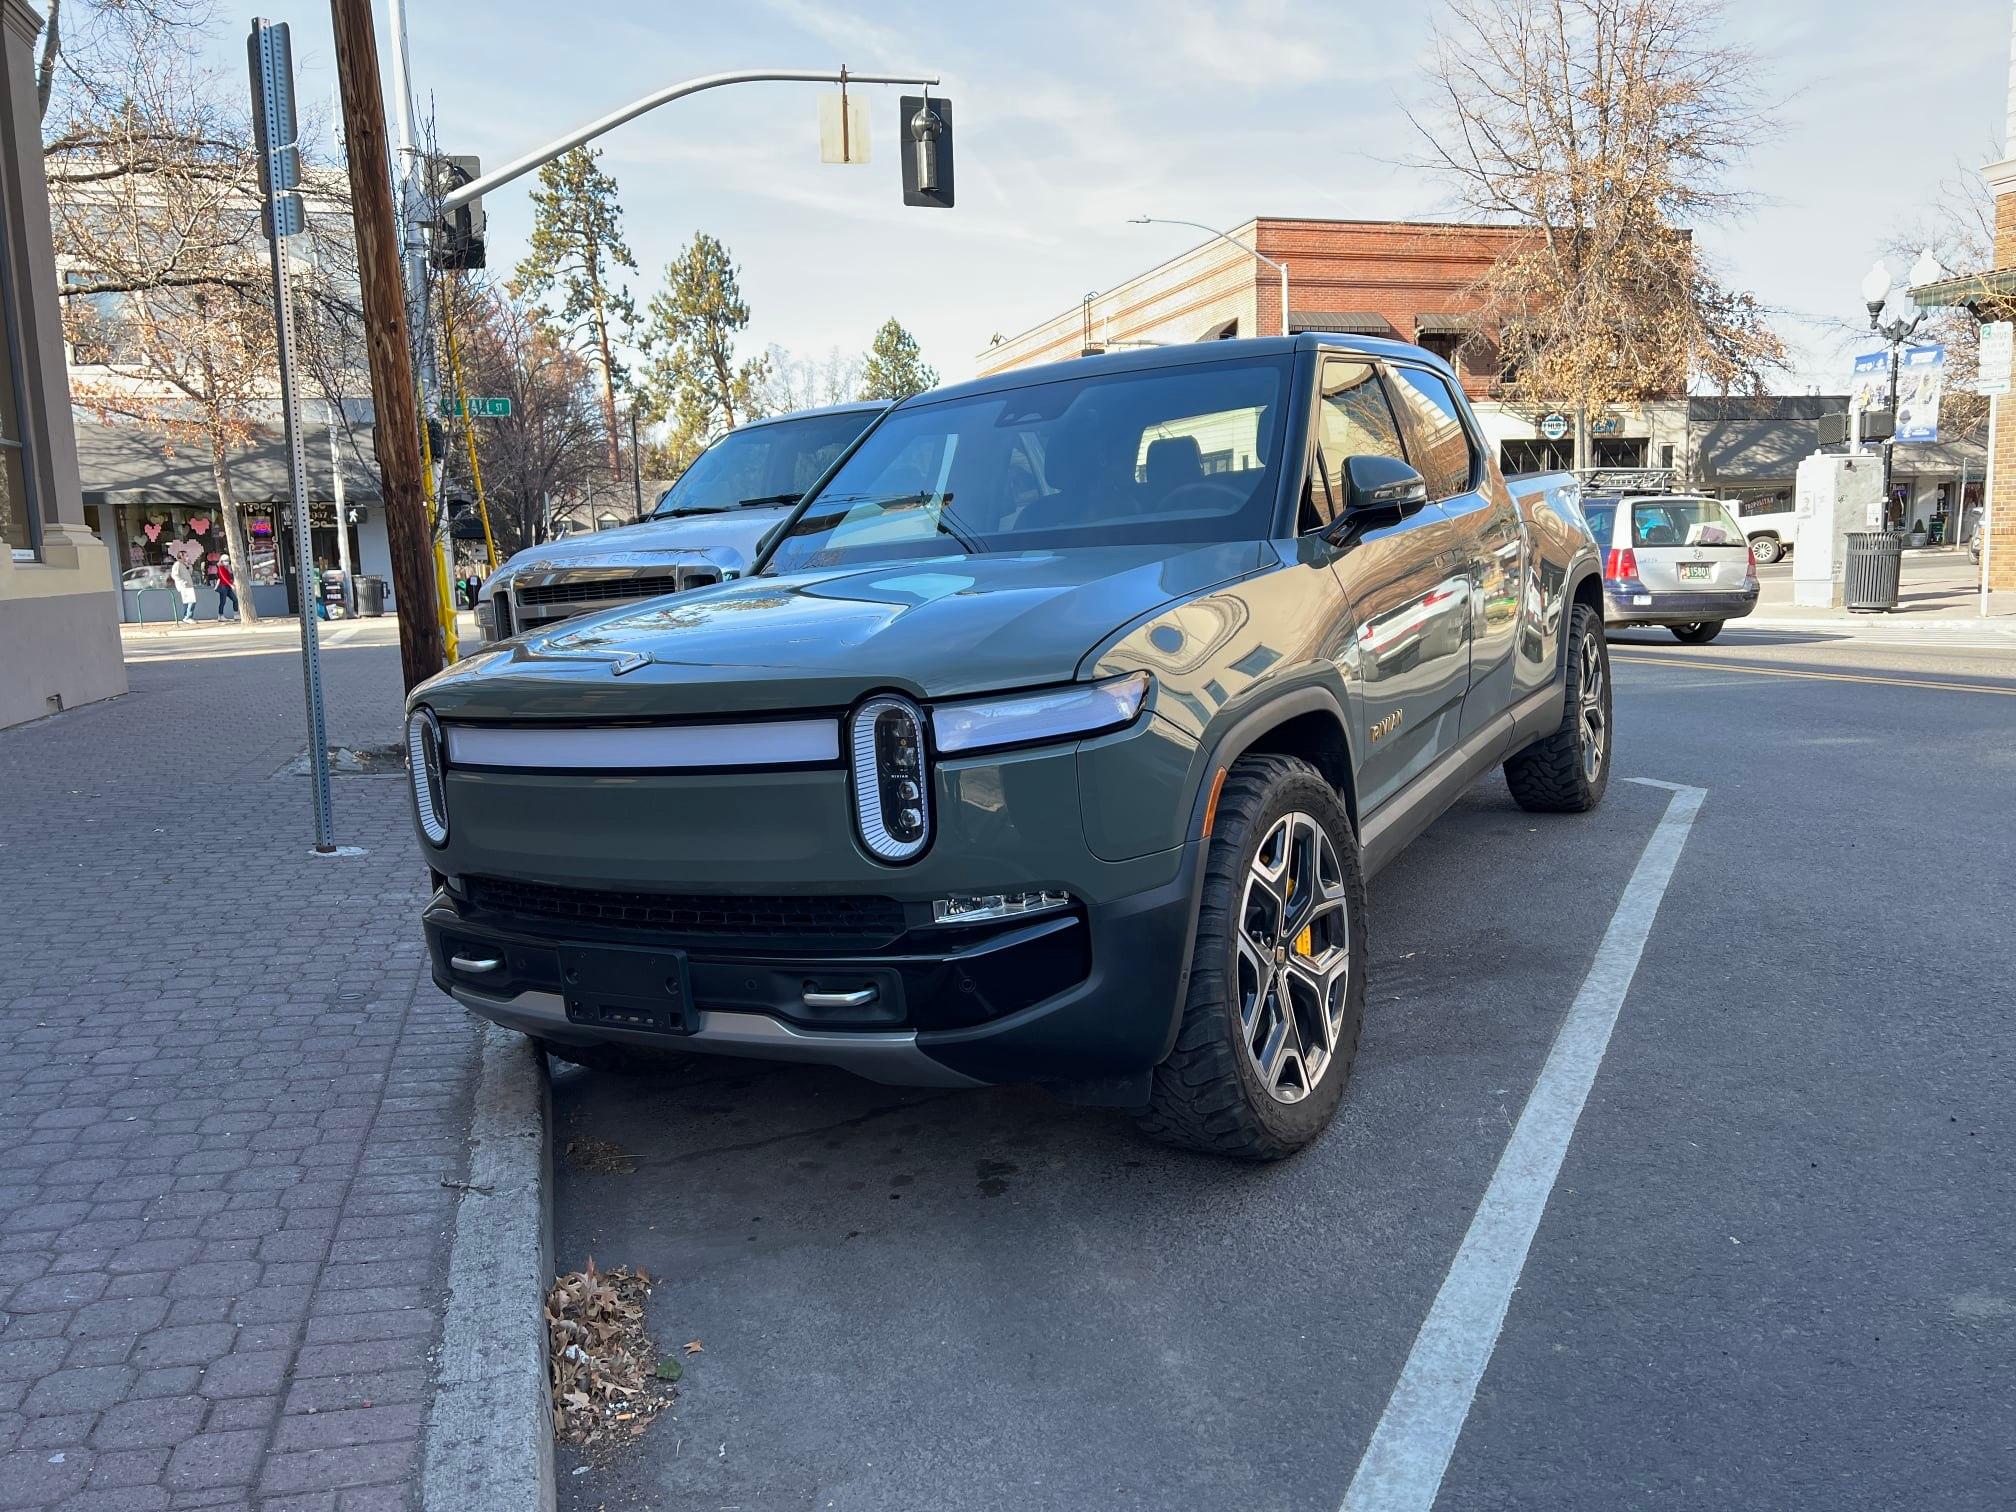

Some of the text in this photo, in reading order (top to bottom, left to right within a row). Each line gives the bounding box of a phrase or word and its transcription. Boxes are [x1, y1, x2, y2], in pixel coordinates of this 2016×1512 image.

[1982, 326, 1991, 339] 2
[495, 402, 503, 412] ST
[1369, 708, 1403, 744] RIVIAN
